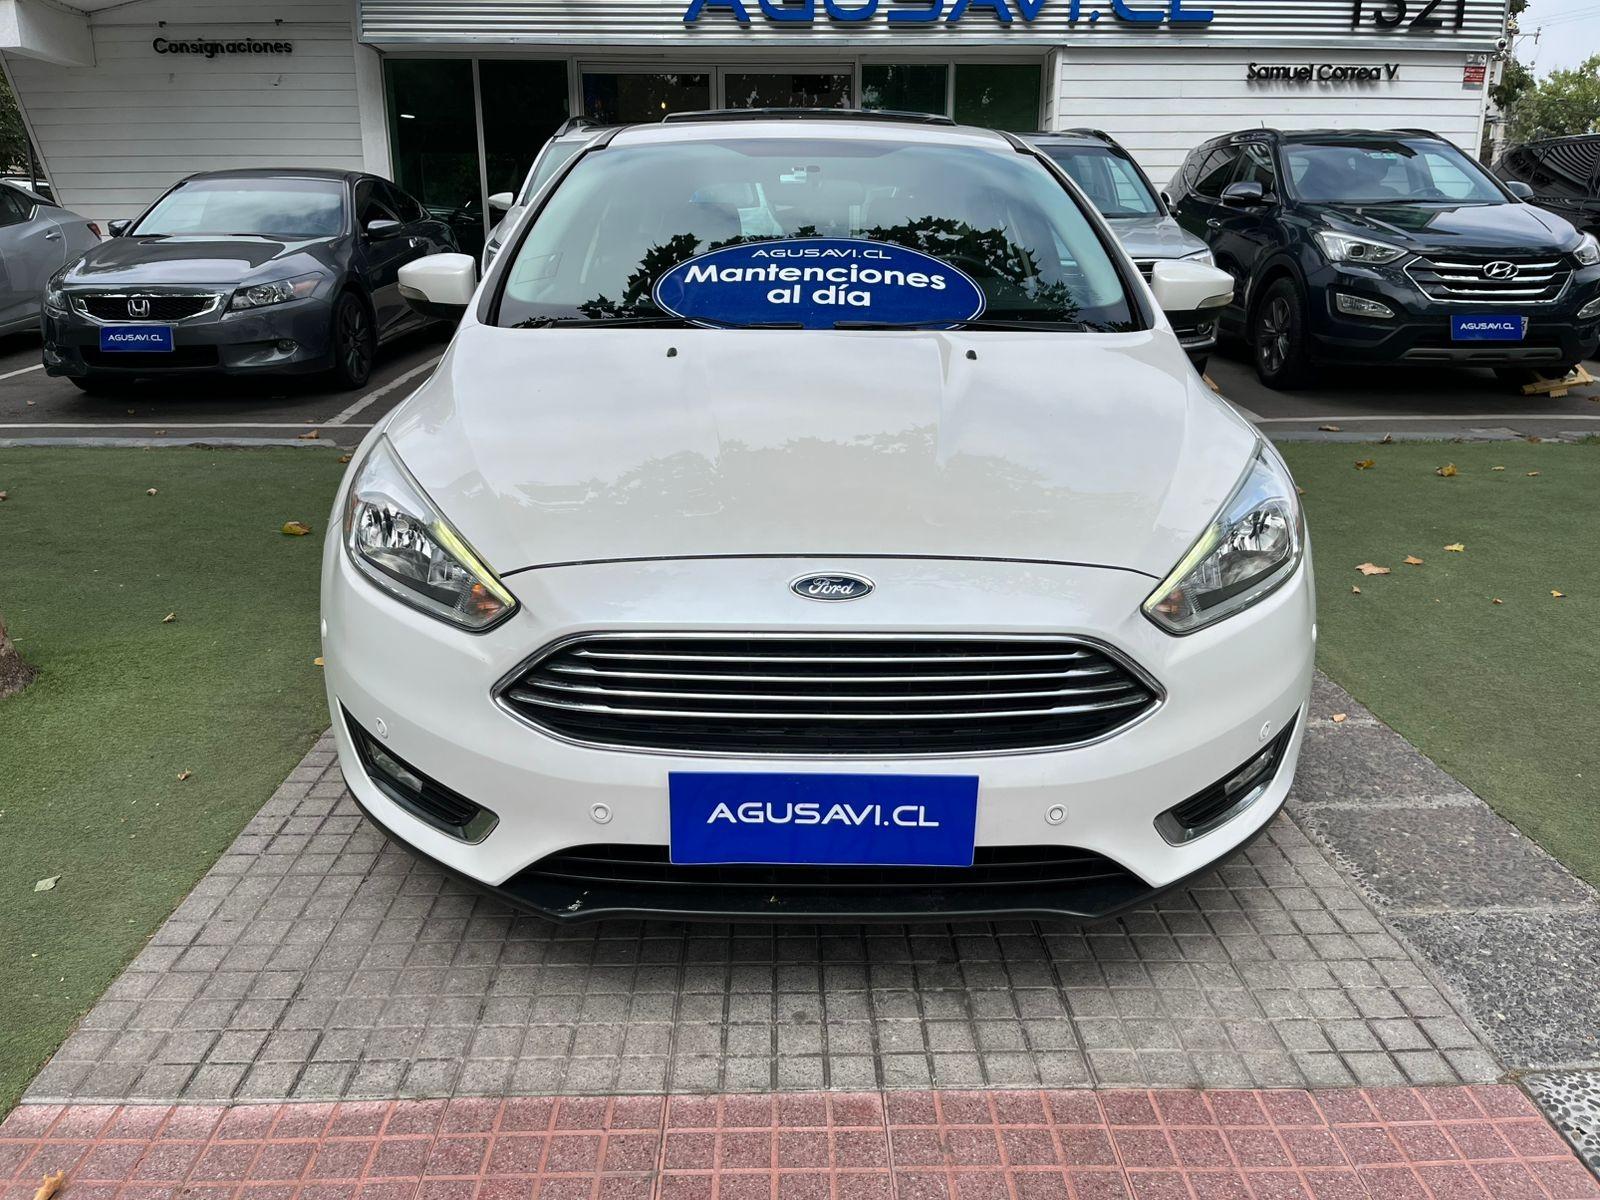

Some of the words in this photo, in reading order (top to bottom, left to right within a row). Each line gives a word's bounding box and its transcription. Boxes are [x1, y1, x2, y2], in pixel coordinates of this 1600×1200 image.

[153, 37, 293, 58] Consignaciones
[1247, 62, 1314, 80] Samuel
[1317, 64, 1381, 80] Correa
[751, 248, 892, 260] AGUSAVI.CL
[684, 264, 946, 290] Mantenciones
[766, 287, 799, 304] al
[812, 284, 871, 307] día
[1460, 322, 1515, 330] AGUSAVI.CL
[808, 577, 855, 594] Ford
[706, 802, 940, 827] AGUSAVI.CL
